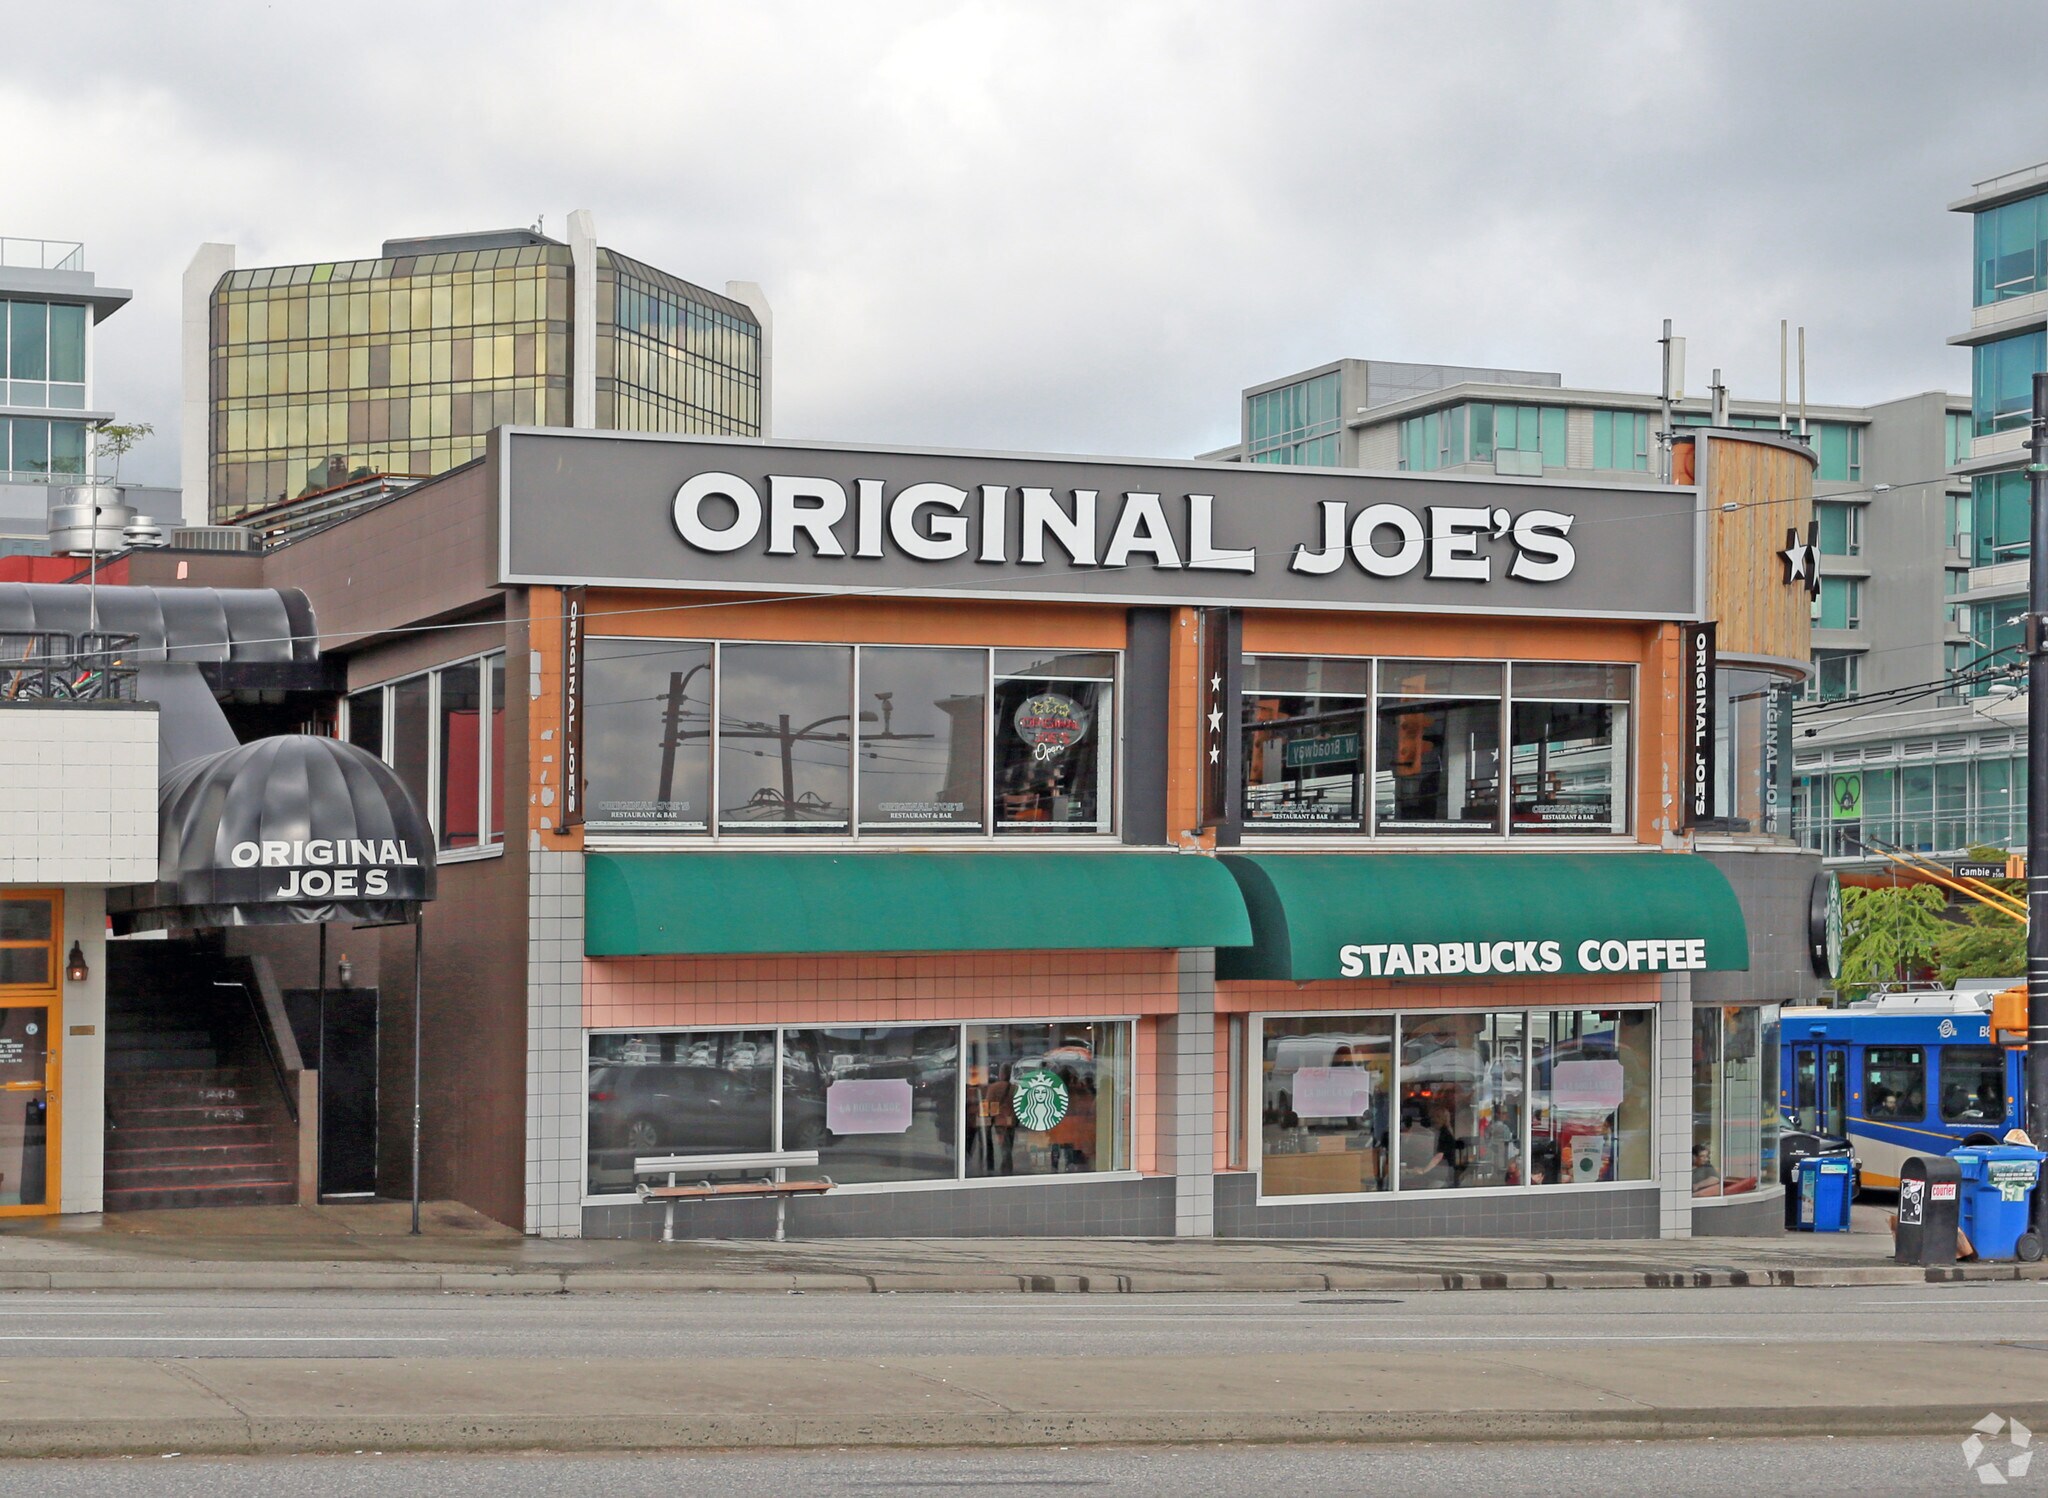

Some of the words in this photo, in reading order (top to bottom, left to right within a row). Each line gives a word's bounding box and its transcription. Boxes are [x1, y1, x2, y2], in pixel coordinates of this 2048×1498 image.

[672, 470, 1256, 575] ORIGINAL
[1288, 499, 1577, 583] JOE'S
[569, 600, 578, 732] ORIGINAL
[1695, 632, 1706, 747] ORIGINAL
[1033, 742, 1065, 761] Open
[1766, 689, 1779, 773] RIGINAL
[1695, 752, 1706, 816] JOE'S
[231, 839, 419, 868] ORIGINAL
[1959, 867, 1990, 877] Cambie
[1339, 940, 1563, 978] STARBUCKS
[1577, 938, 1707, 972] COFFEE
[1932, 1185, 1955, 1196] courier
